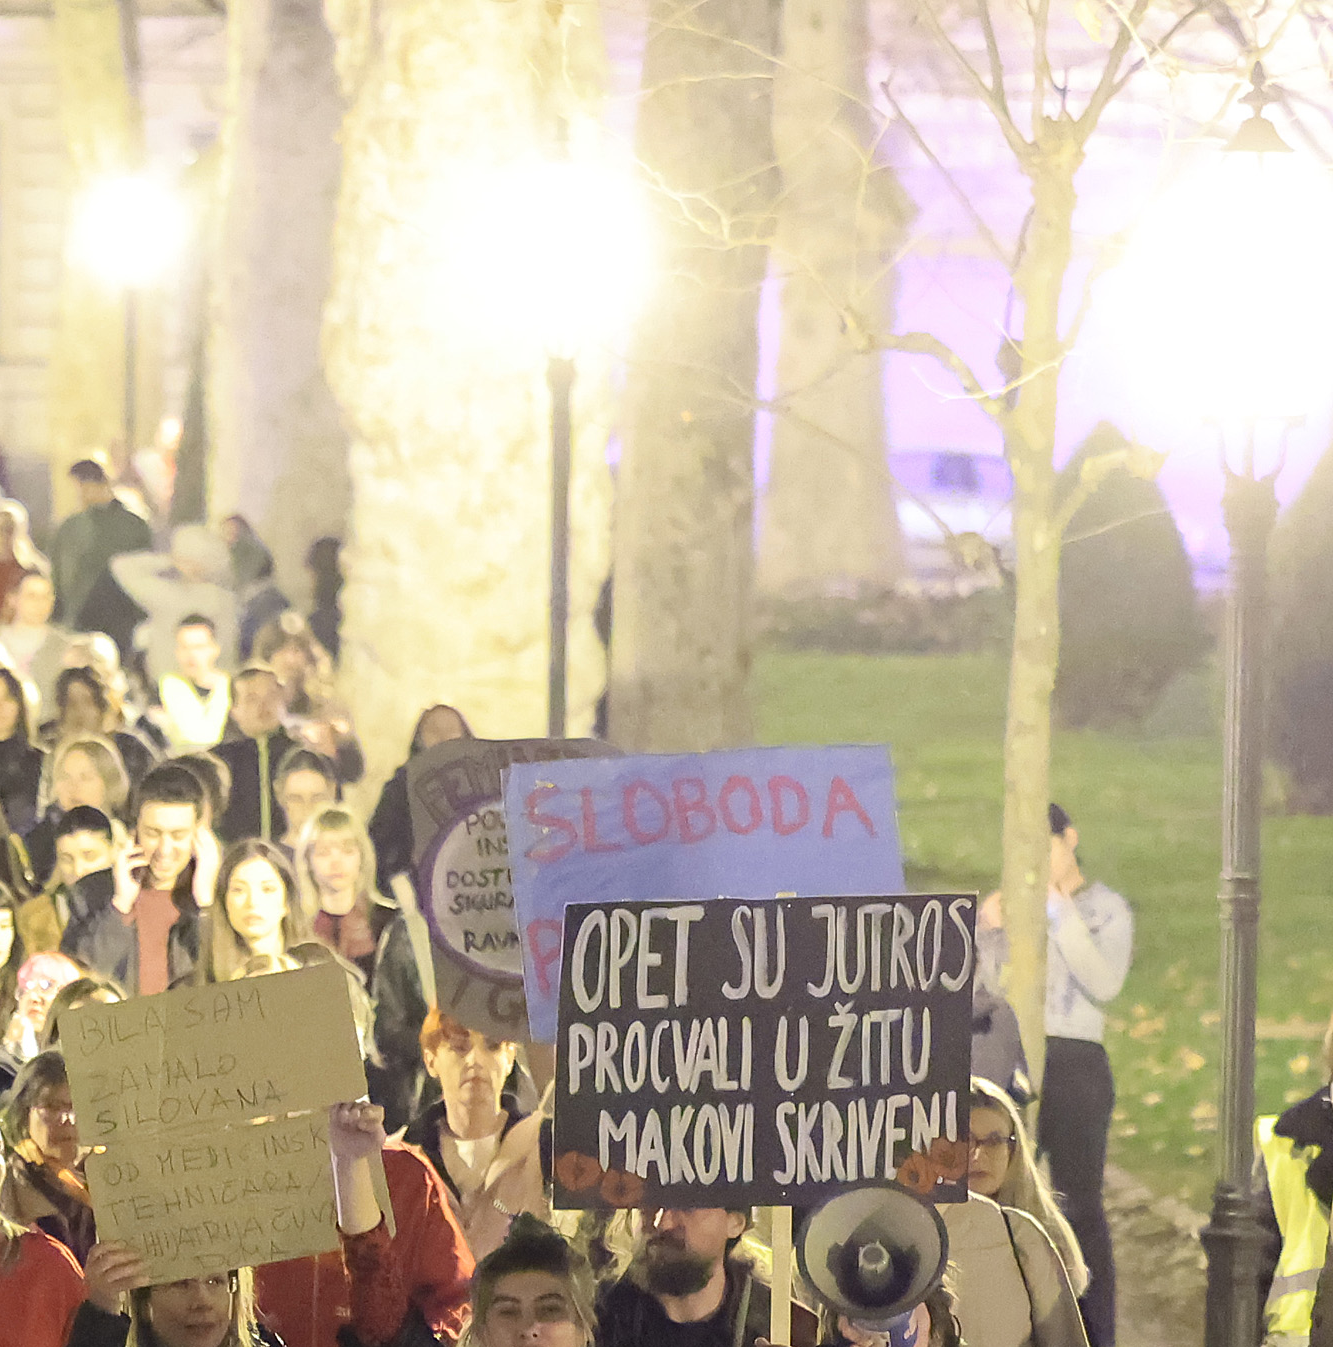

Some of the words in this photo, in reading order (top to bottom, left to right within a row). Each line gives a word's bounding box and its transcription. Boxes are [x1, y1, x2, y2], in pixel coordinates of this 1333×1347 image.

[524, 775, 879, 865] SLOBODA
[446, 868, 512, 889] DOST
[571, 905, 704, 1014] OPET
[721, 903, 788, 1000] SU
[806, 898, 974, 998] JUTROS
[80, 1006, 167, 1057] BILA
[184, 987, 265, 1029] SAM
[568, 1014, 753, 1095] PROCVALI
[774, 1014, 808, 1092] U
[827, 1002, 931, 1090] ŽITU
[89, 1052, 237, 1103] ZAMALO
[95, 1079, 287, 1136] SILOVANA
[156, 1123, 328, 1177] MEDICINSK
[598, 1102, 754, 1187] MAKOVI
[774, 1089, 957, 1186] SKRIVENI
